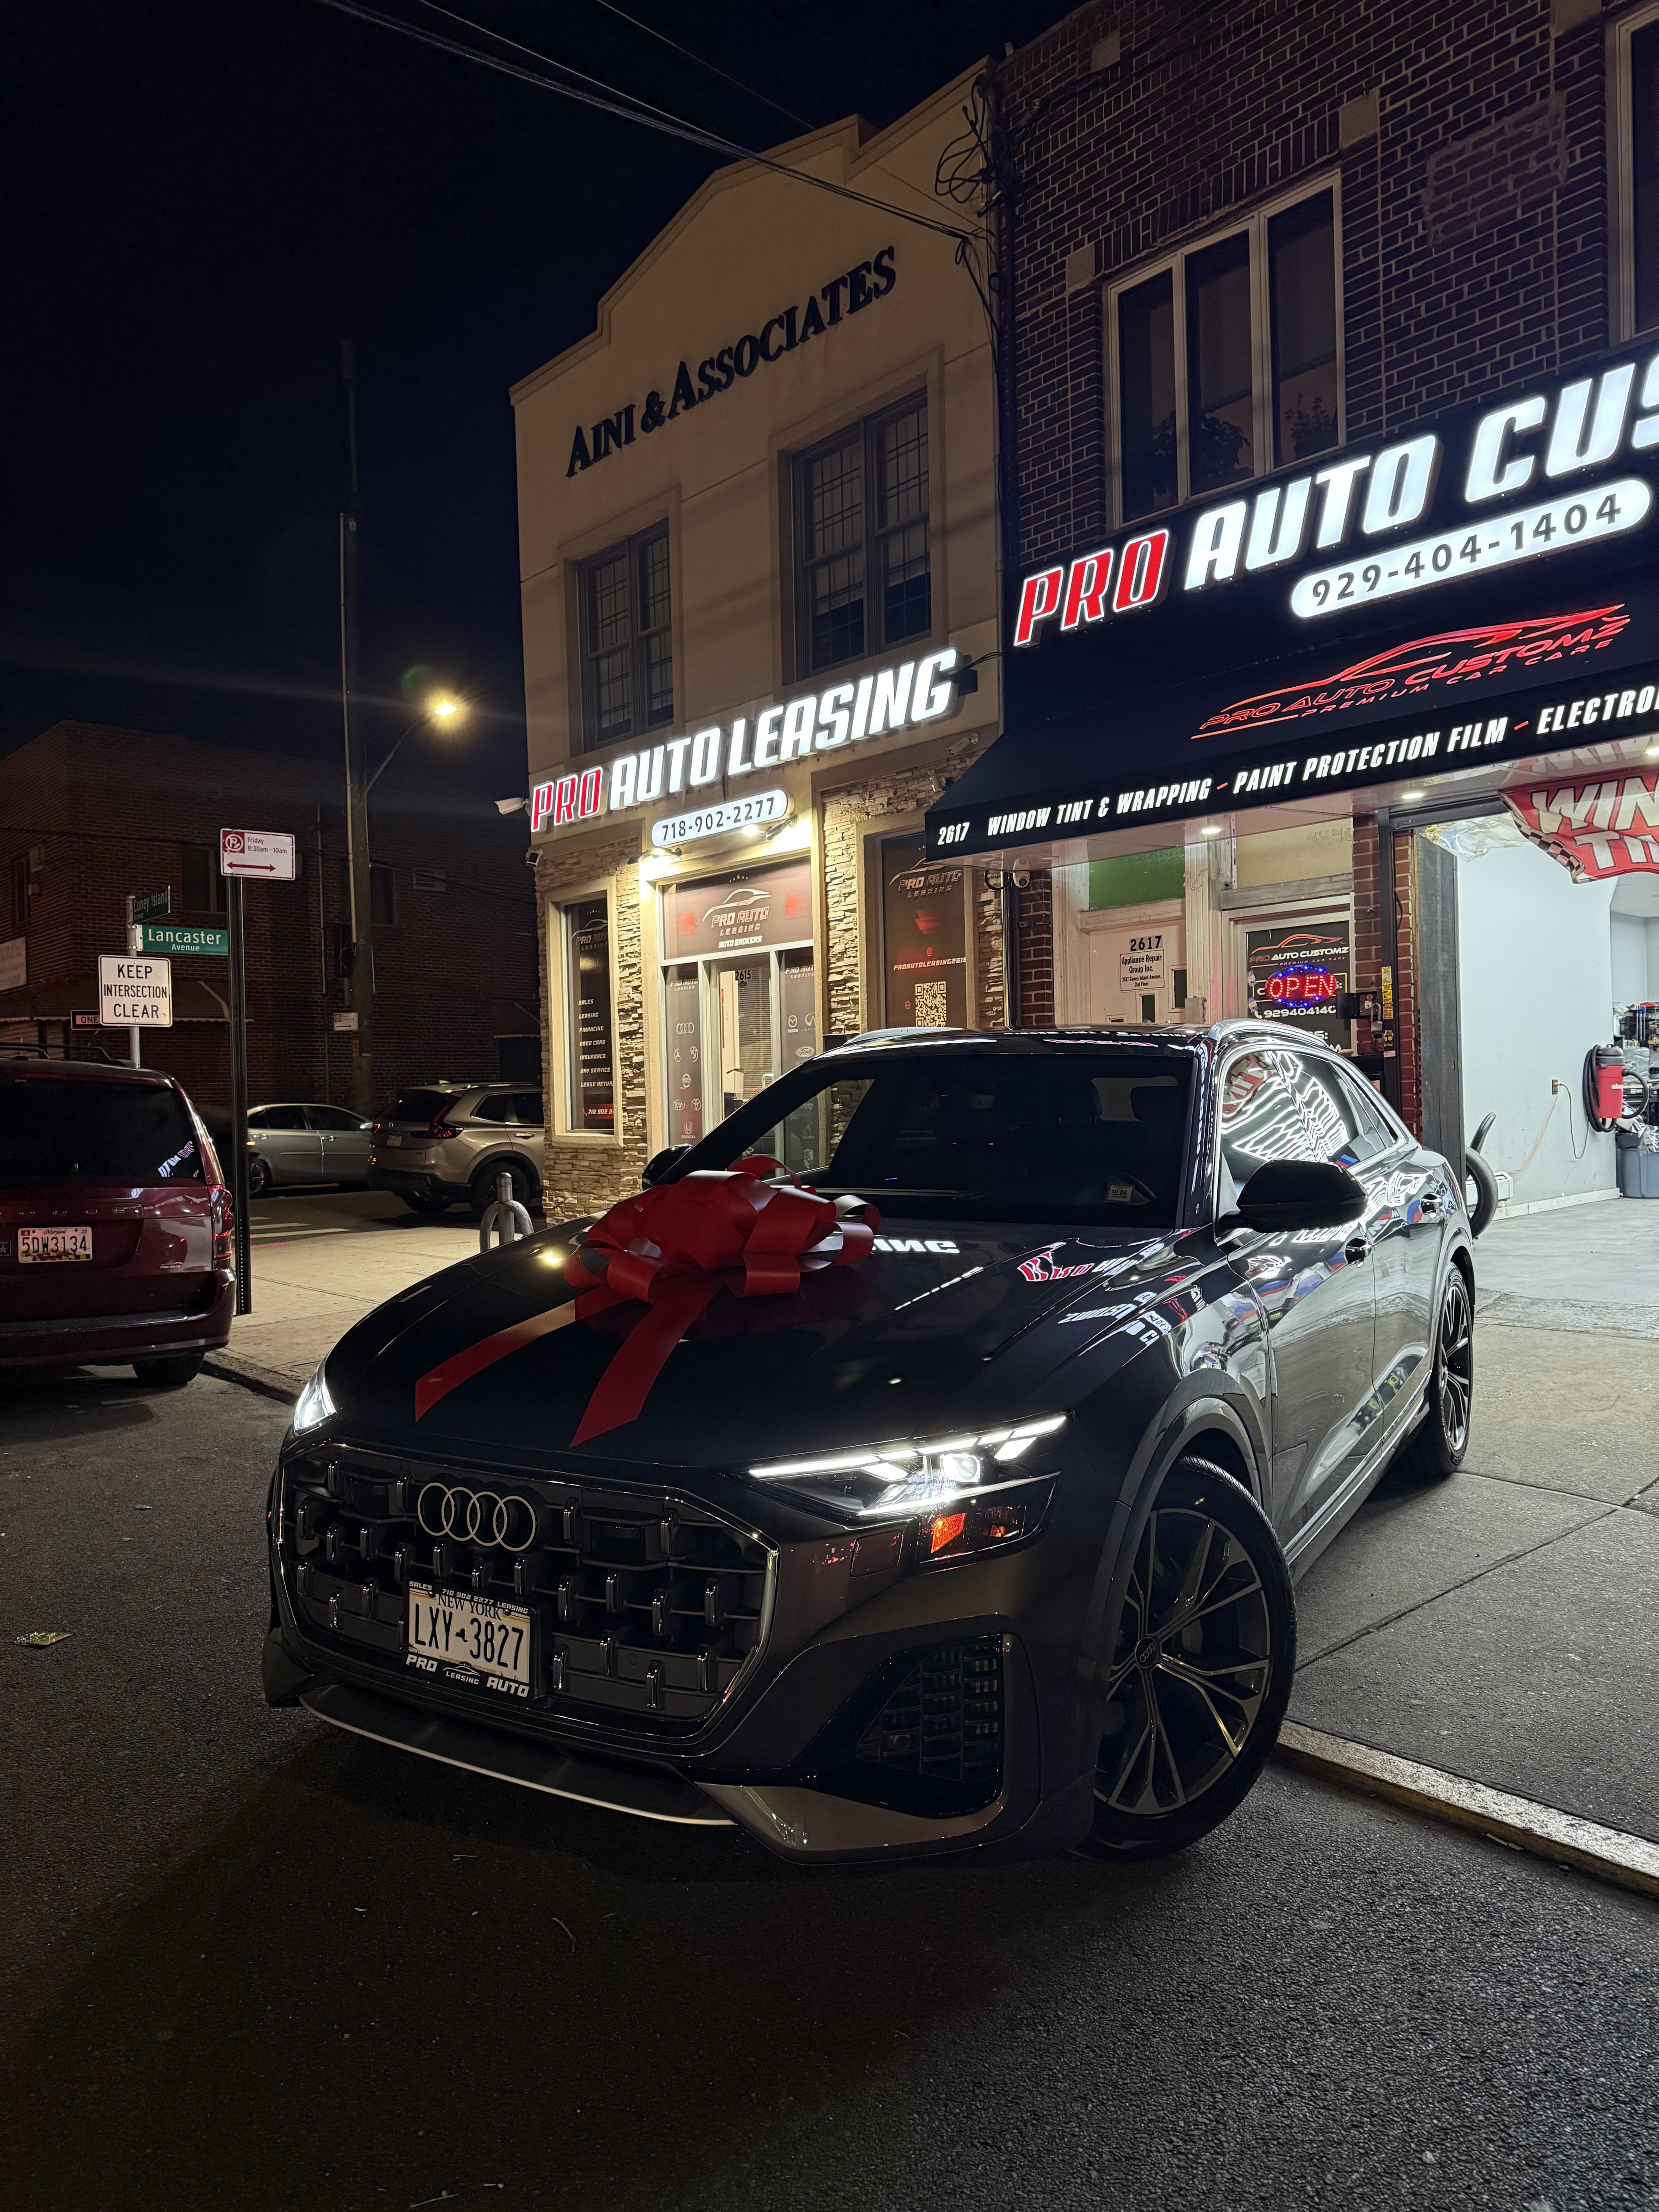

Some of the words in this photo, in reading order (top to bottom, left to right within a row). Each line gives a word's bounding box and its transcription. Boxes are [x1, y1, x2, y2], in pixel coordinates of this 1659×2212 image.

[566, 404, 636, 478] AINI
[640, 391, 666, 433] &
[667, 245, 896, 420] ASSOCIATES
[1013, 528, 1170, 647] PRO
[1183, 435, 1437, 591] AUTO
[1312, 493, 1622, 607] 929-404-1404
[1199, 702, 1281, 730] PRO
[1281, 678, 1395, 712] AUTO
[1405, 618, 1631, 686] CUSTOMZ
[1301, 684, 1429, 717] PREMIUM
[1446, 665, 1507, 685] CAR
[1524, 639, 1613, 666] CARE
[530, 766, 604, 833] PRO
[609, 725, 721, 810] AUTO
[727, 648, 957, 776] LEASING
[937, 822, 970, 845] 2617
[987, 806, 1052, 836] WINDOW
[1056, 799, 1093, 825] TINT
[1097, 796, 1110, 817] &
[1116, 778, 1212, 814] WRAPPING
[1233, 761, 1297, 794] PAINT
[1302, 731, 1440, 782] PROTECTION
[1446, 717, 1508, 753] FILM
[1536, 685, 1659, 735] ELECTRO
[661, 797, 775, 842] 718-902-2277
[898, 876, 925, 892] PRO
[926, 869, 962, 887] AUTO
[133, 897, 149, 912] Coney
[151, 888, 167, 907] Island
[907, 885, 953, 899] LEASING
[711, 912, 736, 928] PRO
[736, 906, 770, 925] AUTO
[148, 928, 222, 945] Lancaster
[719, 923, 761, 937] LEASING
[172, 943, 200, 952] Avenue
[718, 941, 734, 949] AUTO
[734, 935, 763, 947] BROKERS
[1130, 935, 1162, 952] 2617
[1122, 956, 1144, 966] Appliance
[1146, 953, 1162, 963] Repair
[1249, 955, 1271, 963] PRO
[1271, 951, 1300, 961] AUTO
[1300, 946, 1350, 958] CUSTOMZ
[117, 964, 153, 979] KEEP
[735, 969, 751, 981] 2615
[1129, 966, 1144, 974] Group
[103, 984, 168, 999] INTERSECTION
[1268, 975, 1336, 998] OPEN
[80, 1015, 99, 1023] ONE
[113, 1003, 159, 1019] CLEAR
[1263, 1005, 1337, 1018] 929404140
[22, 1235, 87, 1253] 5DW3134
[409, 1581, 432, 1591] SALES
[456, 1592, 471, 1601] 902
[473, 1595, 494, 1605] 2277
[497, 1601, 529, 1615] LEASING
[437, 1594, 467, 1611] NEW
[469, 1600, 503, 1621] YORK
[405, 1653, 438, 1672] PRO
[486, 1676, 530, 1698] AUTO
[445, 1671, 480, 1685] LEASING
